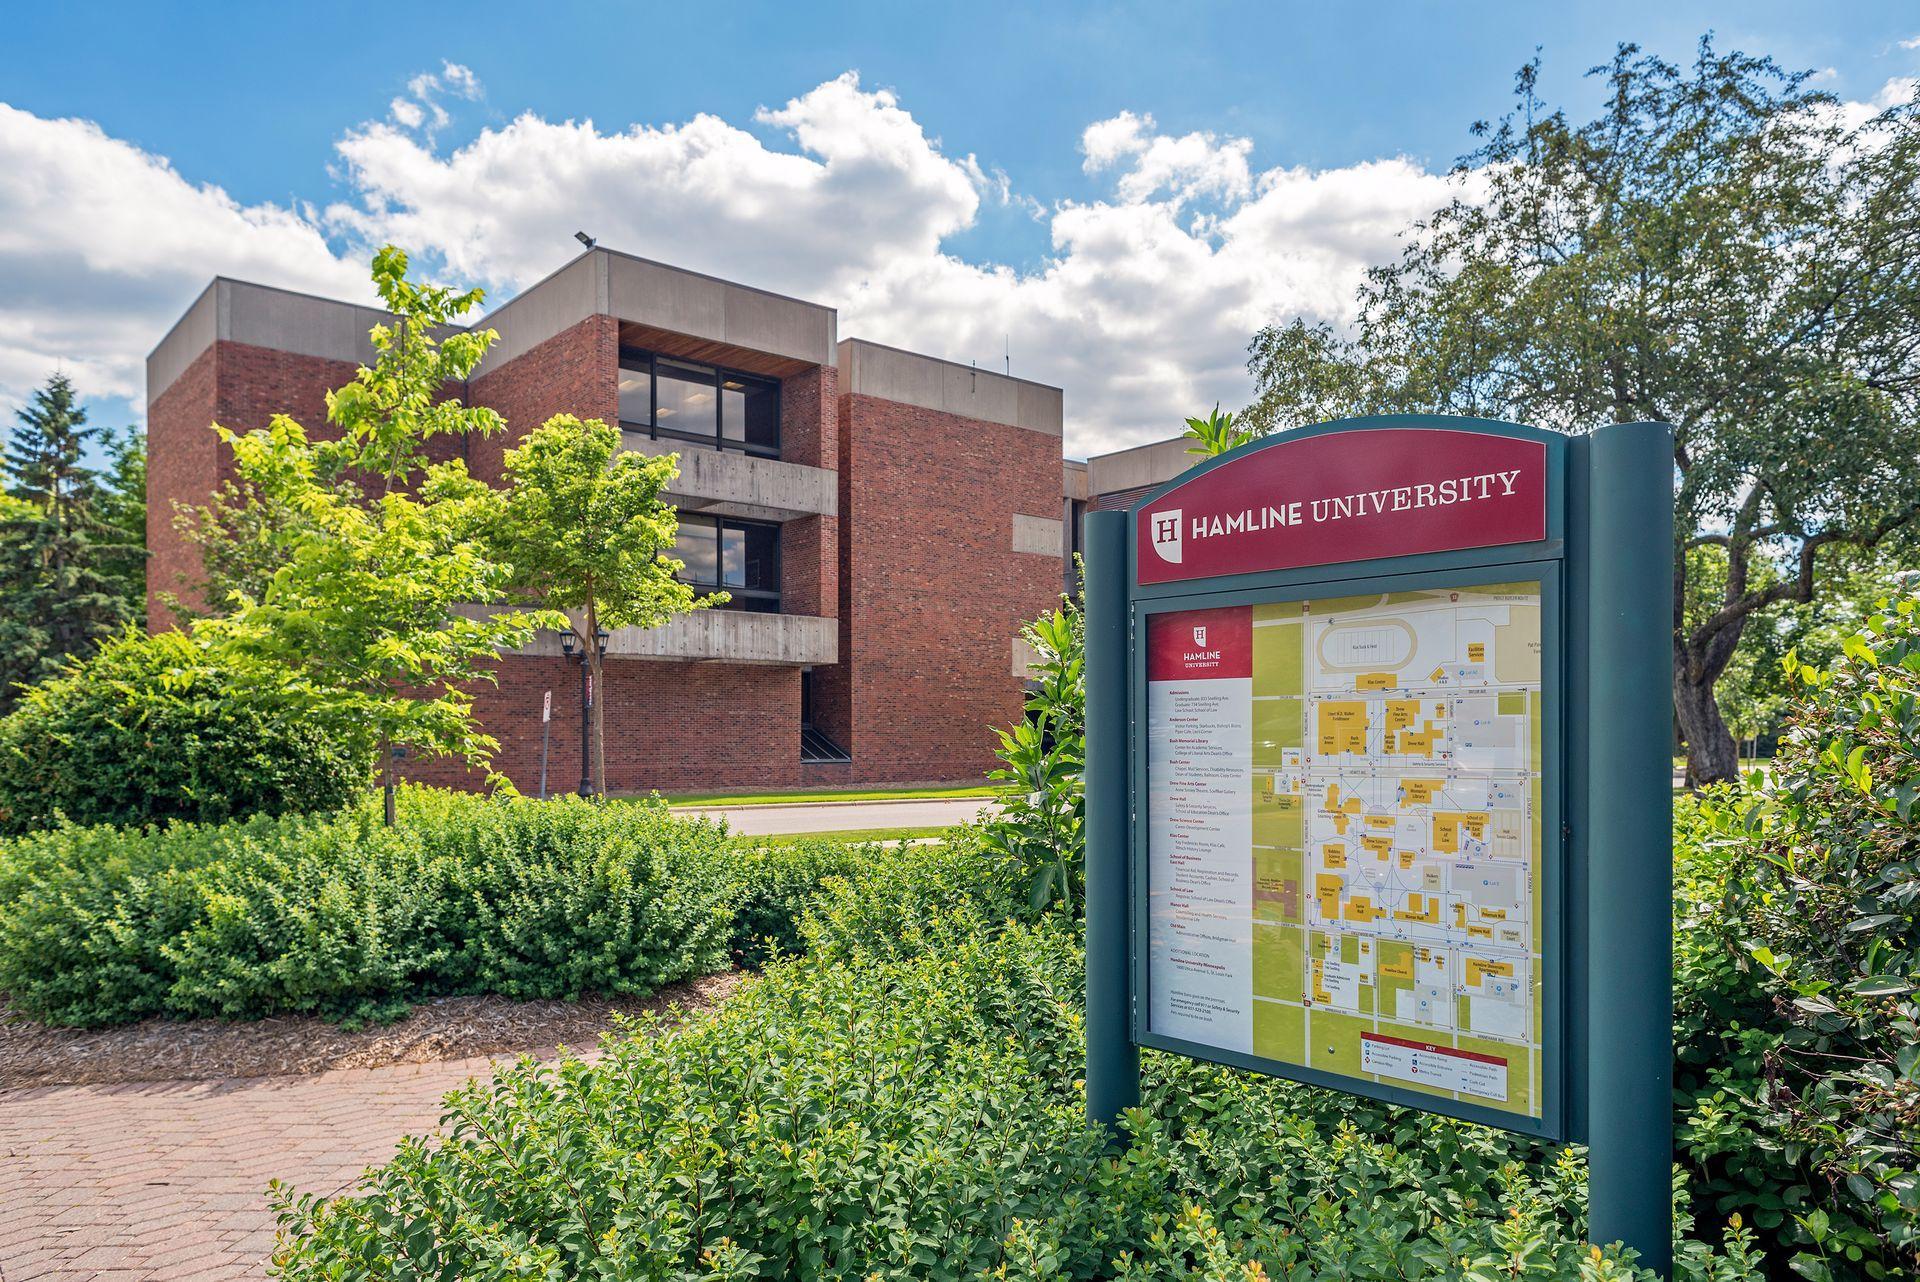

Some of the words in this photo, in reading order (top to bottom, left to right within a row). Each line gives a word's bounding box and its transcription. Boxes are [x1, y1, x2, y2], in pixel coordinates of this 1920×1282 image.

[1157, 519, 1178, 543] H
[1192, 502, 1302, 540] HAMLINE
[1310, 470, 1520, 523] UNIVERSITY
[1196, 630, 1204, 640] H
[1184, 651, 1220, 661] HAMLINE
